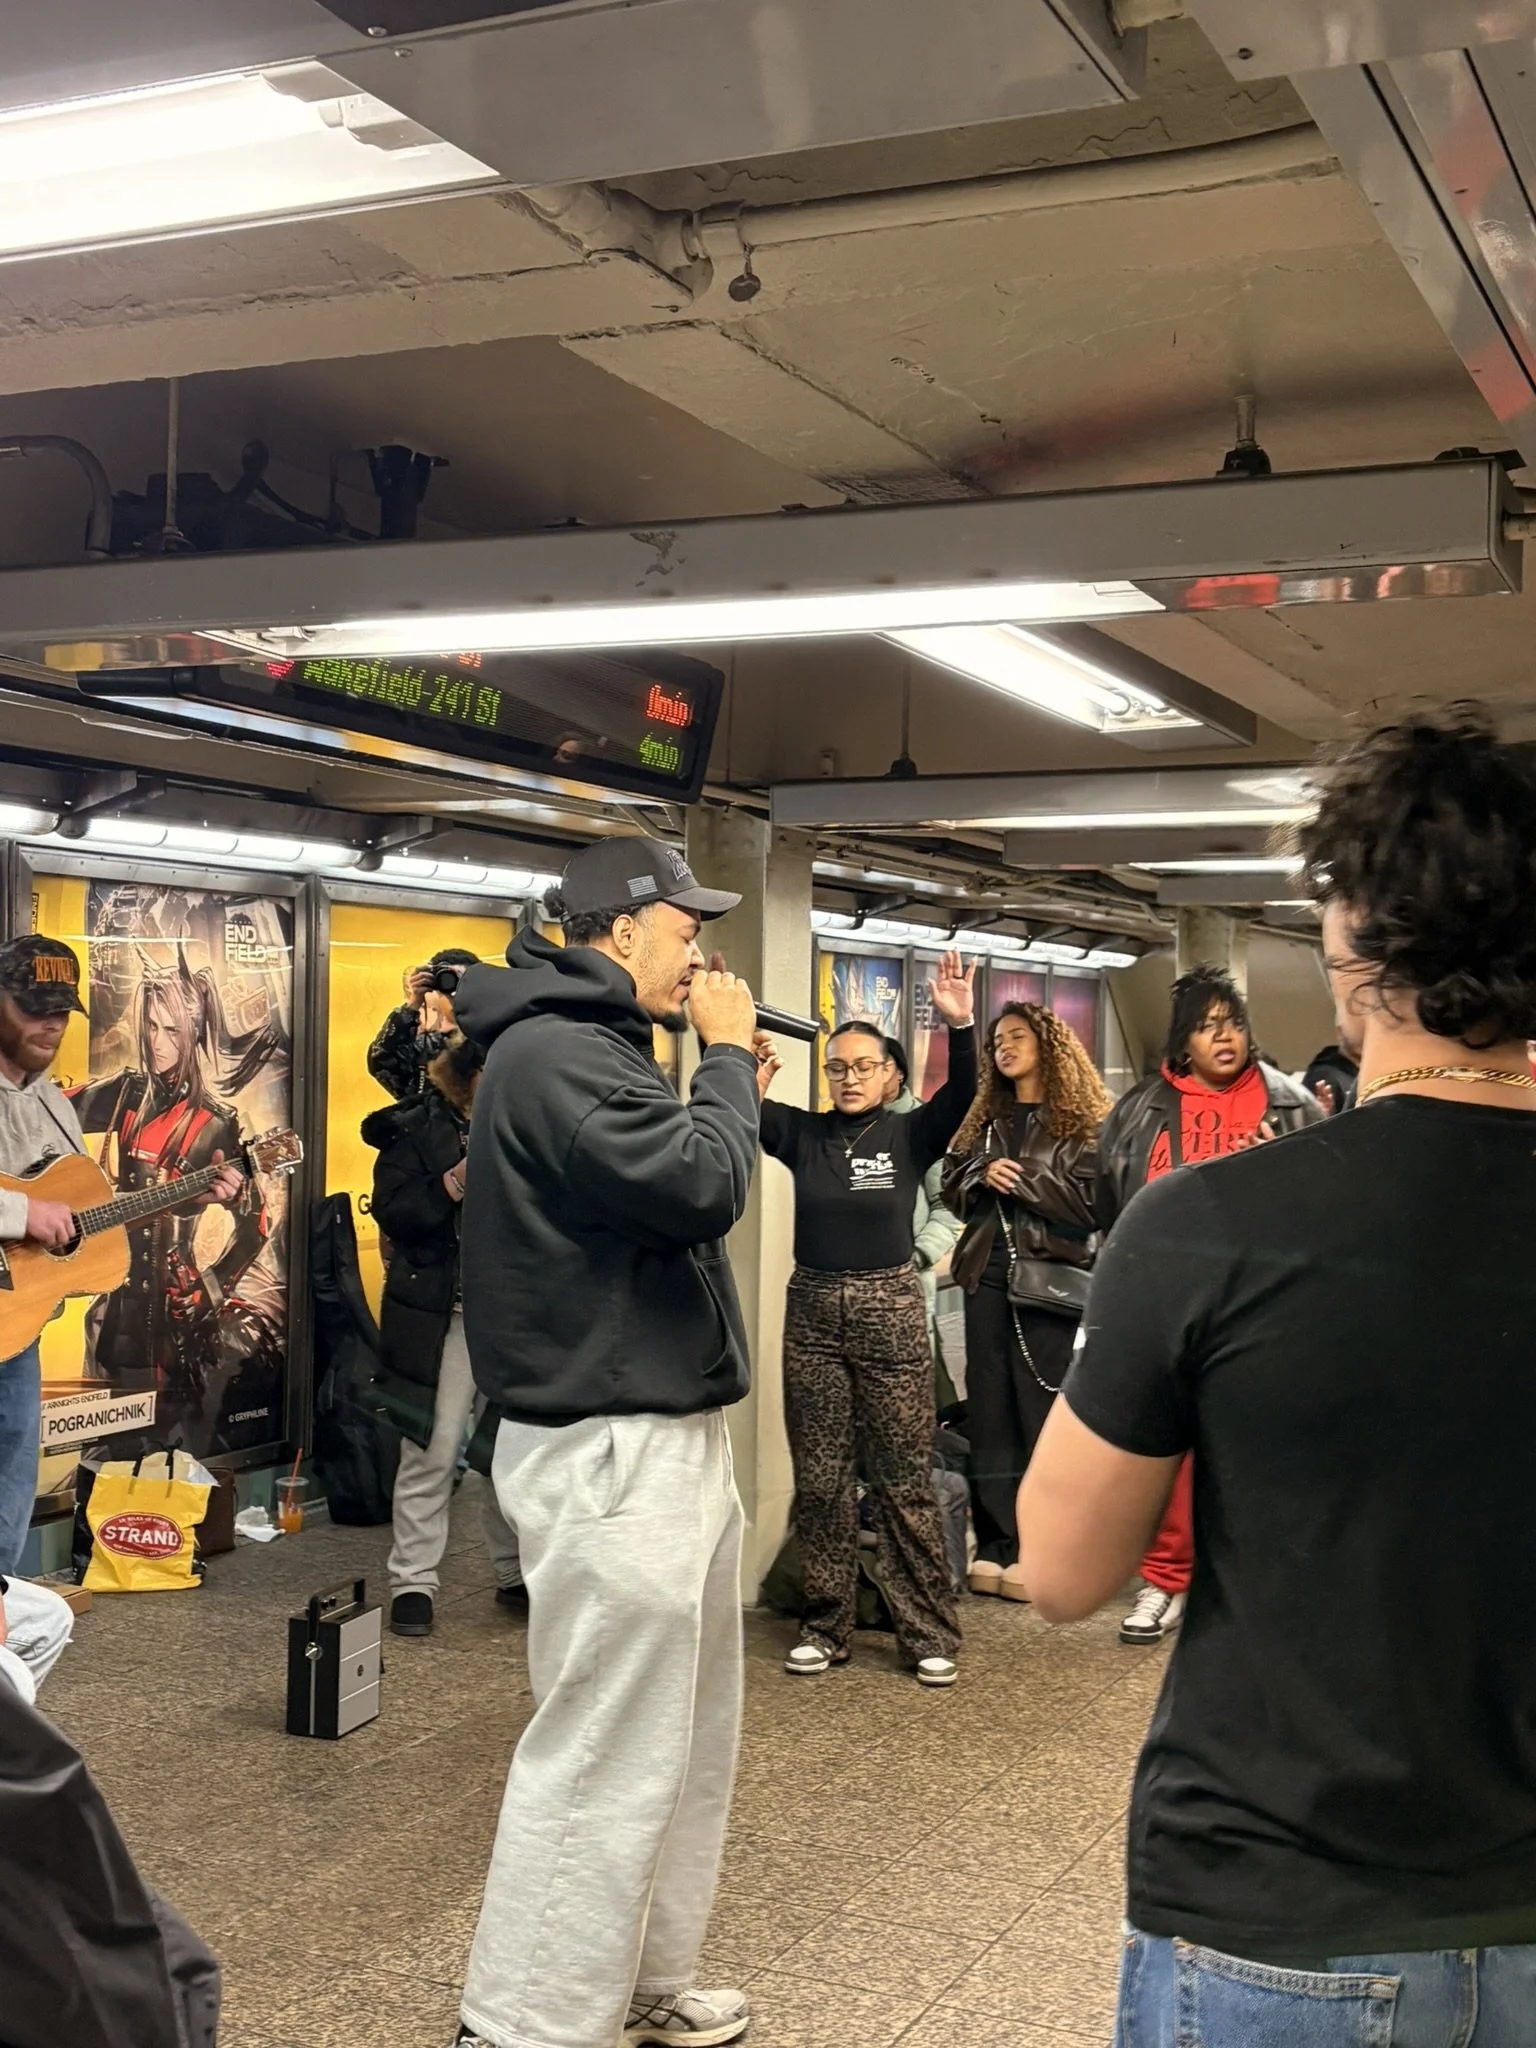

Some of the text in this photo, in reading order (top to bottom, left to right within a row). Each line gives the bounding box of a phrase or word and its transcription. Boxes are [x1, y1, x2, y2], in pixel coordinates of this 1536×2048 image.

[639, 731, 679, 771] 4min
[225, 923, 257, 944] END
[225, 942, 267, 963] FIELD
[48, 1402, 146, 1435] POGRANICHNIK
[104, 1525, 179, 1547] STRAND
